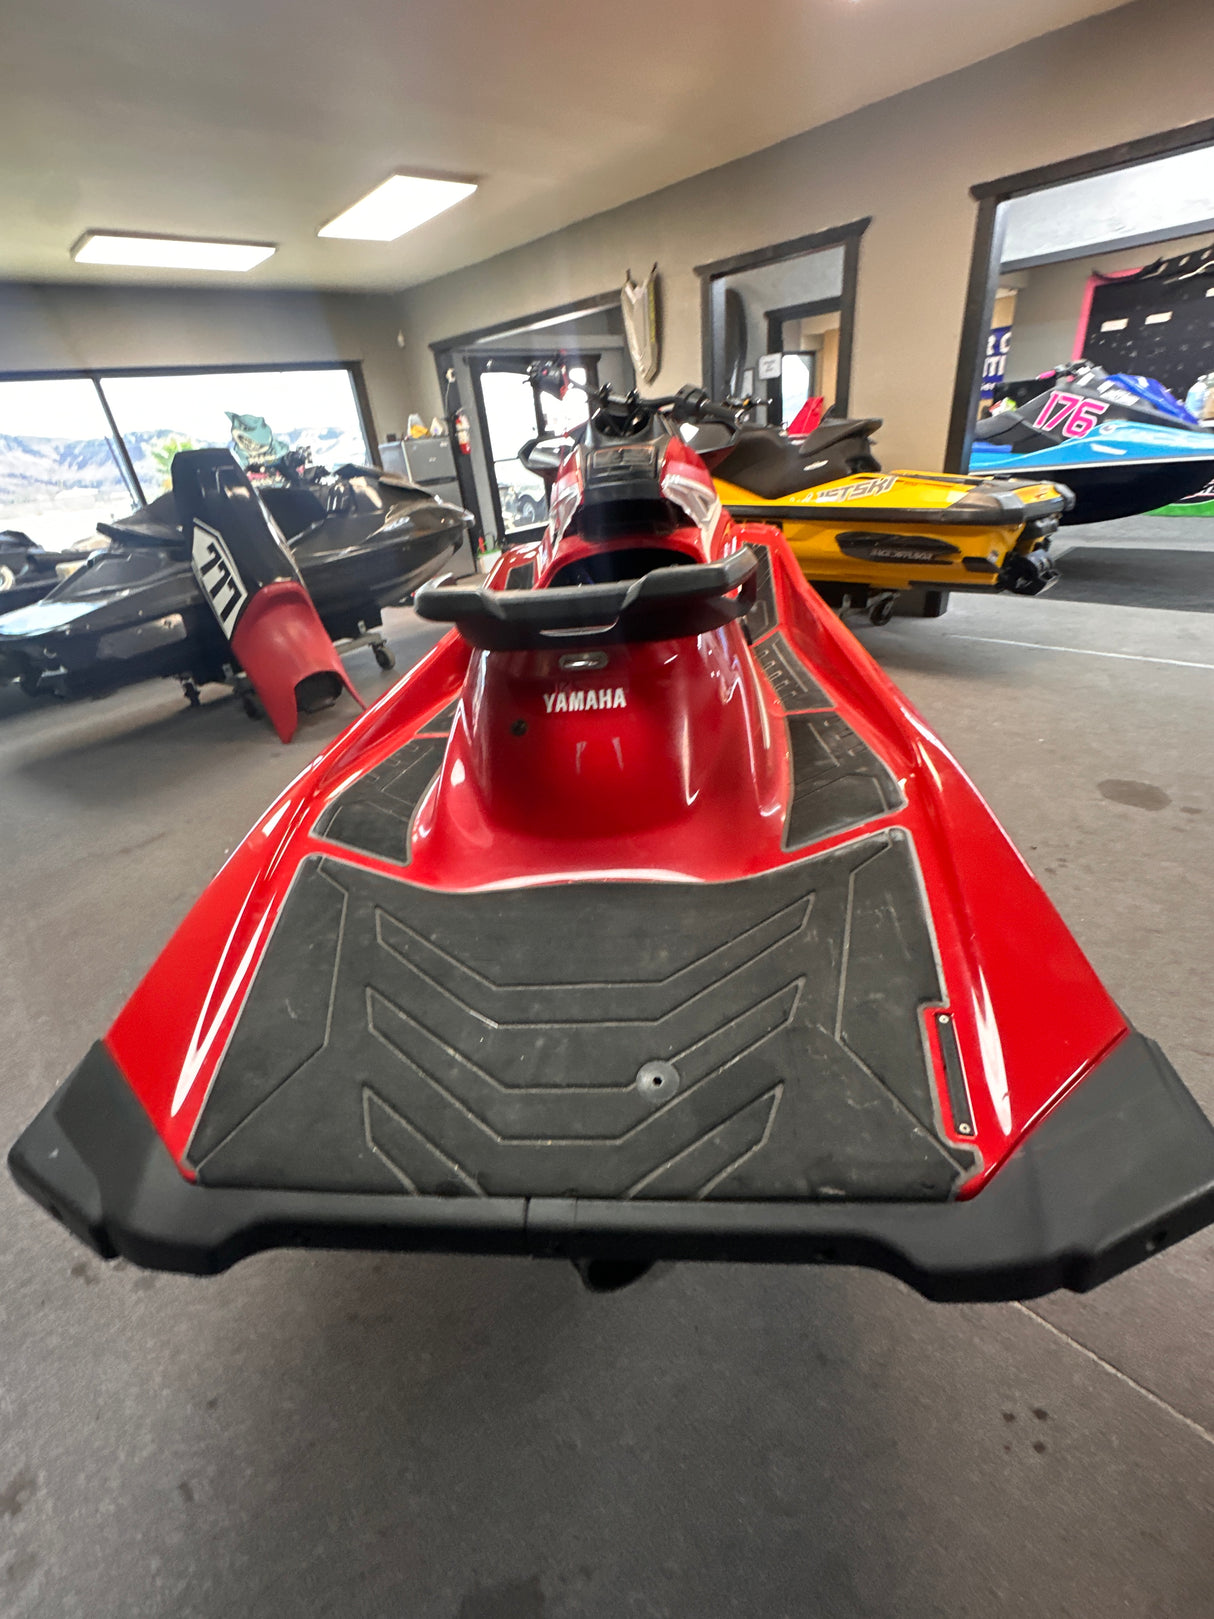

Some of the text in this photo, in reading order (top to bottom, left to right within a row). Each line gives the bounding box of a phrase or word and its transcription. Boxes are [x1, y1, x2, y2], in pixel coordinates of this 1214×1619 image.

[1033, 390, 1110, 439] 176
[200, 541, 243, 624] 777
[543, 687, 627, 714] YAMAHA
